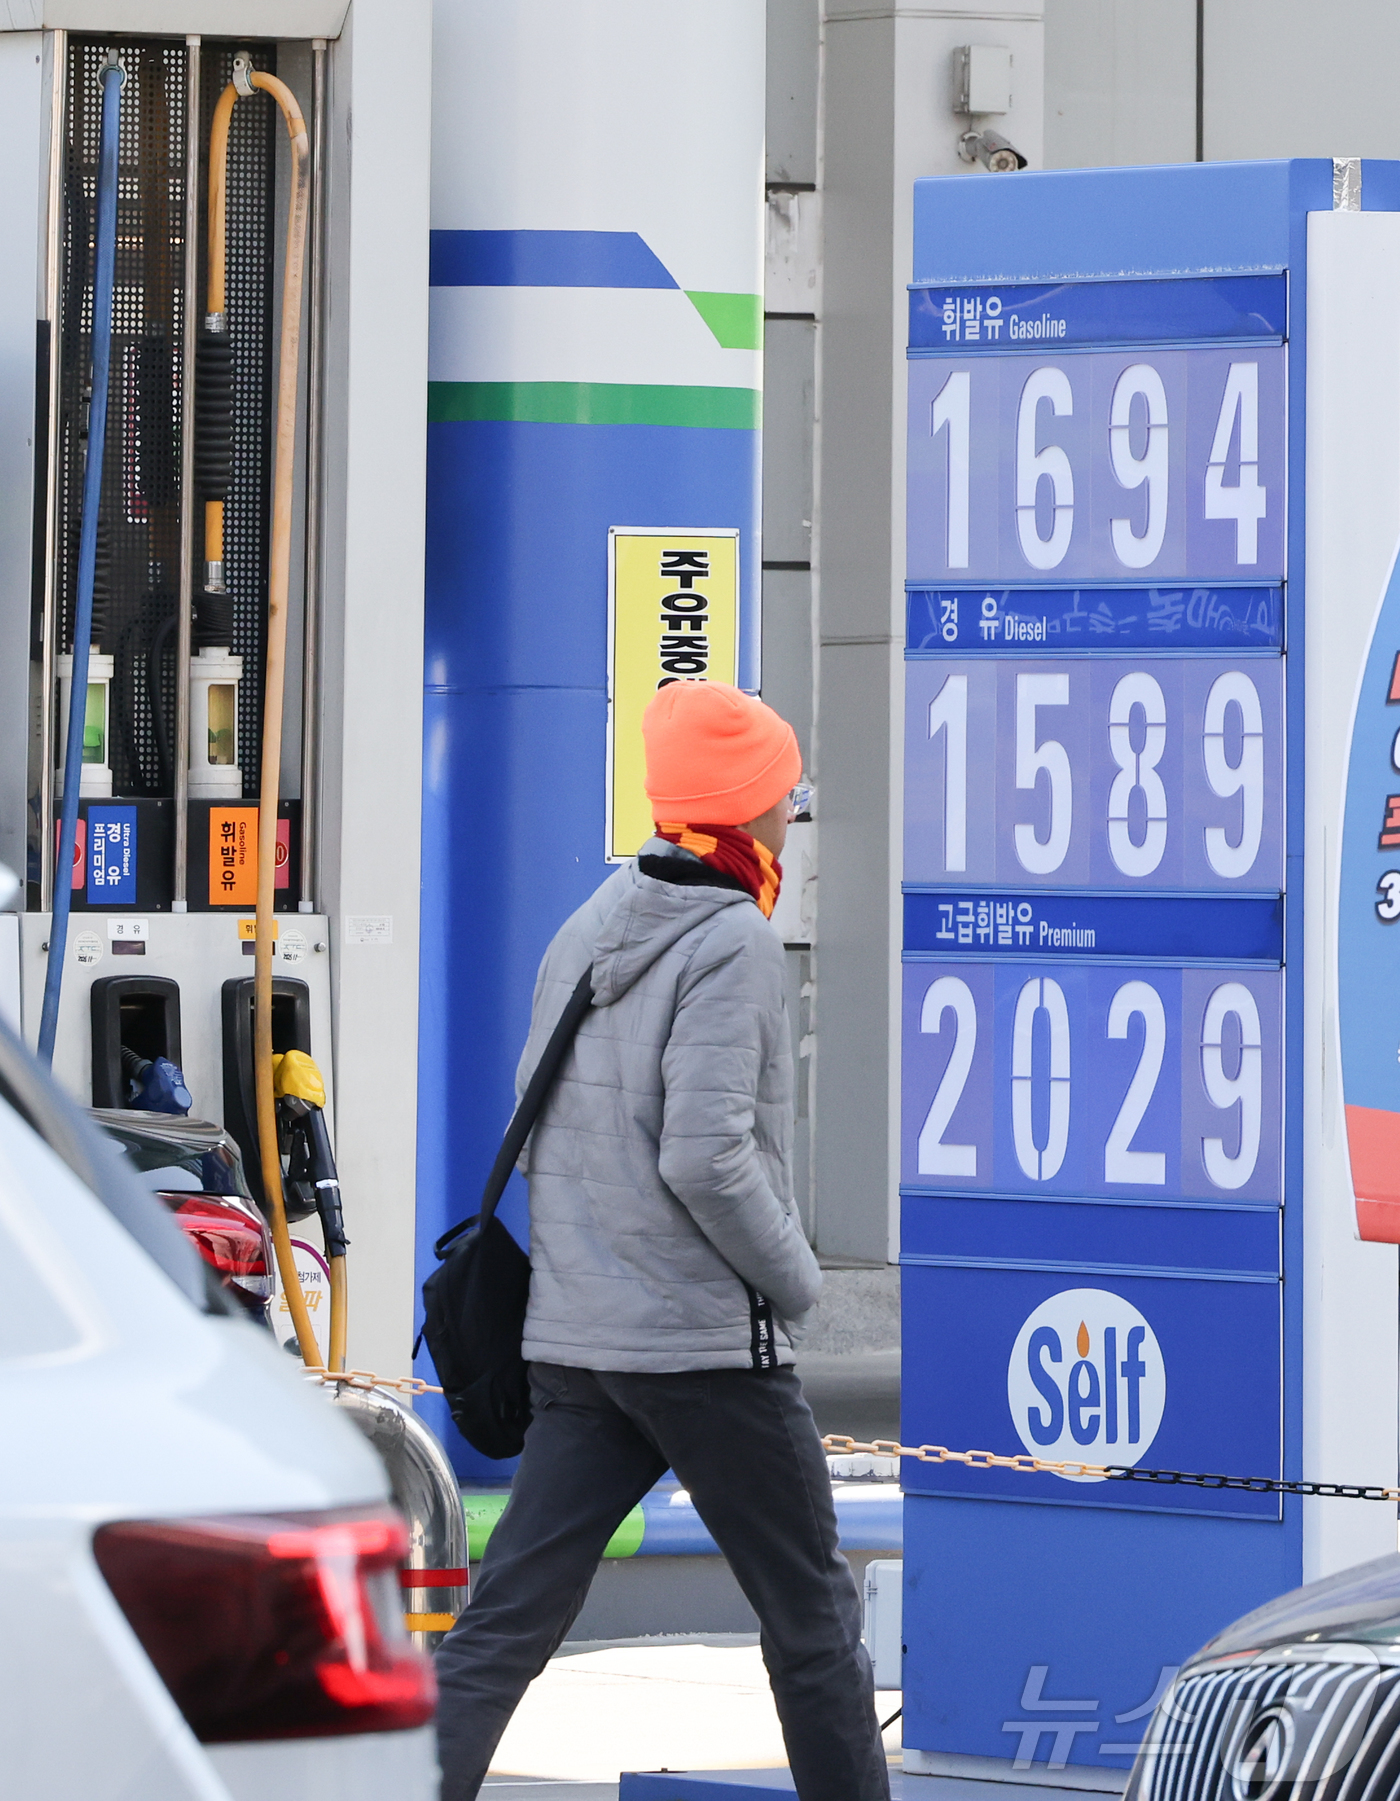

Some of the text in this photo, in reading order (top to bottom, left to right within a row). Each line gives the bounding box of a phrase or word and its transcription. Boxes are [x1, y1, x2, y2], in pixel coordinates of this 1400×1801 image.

[942, 296, 1067, 341] 휘발유 Gasoline
[930, 362, 1267, 570] 1694
[657, 550, 710, 691] 주유중
[1004, 616, 1047, 642] Diesel
[928, 670, 1264, 879] 1589
[93, 823, 106, 886] 프리미엄
[123, 823, 131, 876] Ultra Diesel
[220, 821, 237, 891] 휘발유
[239, 821, 247, 866] Gasoline
[936, 900, 1096, 948] 고급휘발유 Premium
[917, 975, 1263, 1190] 2029
[1027, 1324, 1146, 1446] Self
